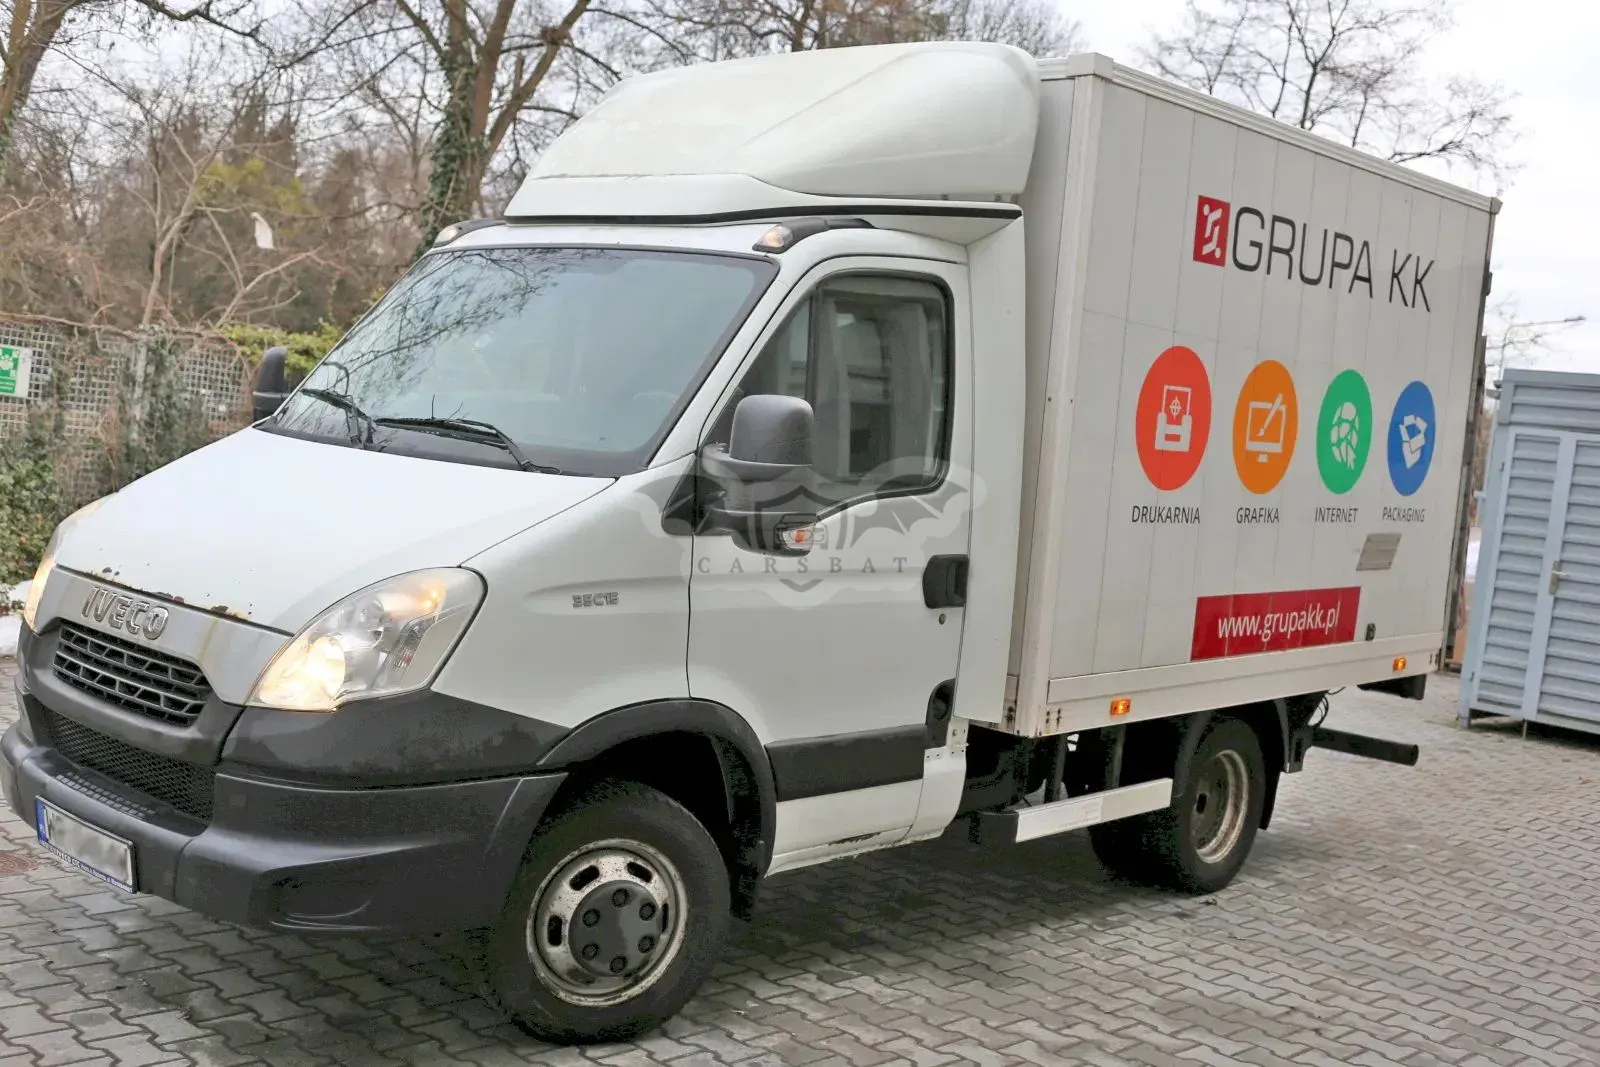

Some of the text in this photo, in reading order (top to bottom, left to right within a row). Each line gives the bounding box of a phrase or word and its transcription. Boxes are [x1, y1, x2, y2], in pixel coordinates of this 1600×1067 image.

[1232, 206, 1434, 312] GRUPA KK
[1131, 505, 1200, 524] DRUKARNIA
[1236, 507, 1280, 524] GRAFIKA
[1315, 507, 1359, 523] INTERNET
[1382, 506, 1425, 523] PACKAGING
[81, 586, 170, 641] IVECO
[1218, 601, 1341, 642] www.grupakk.pl
